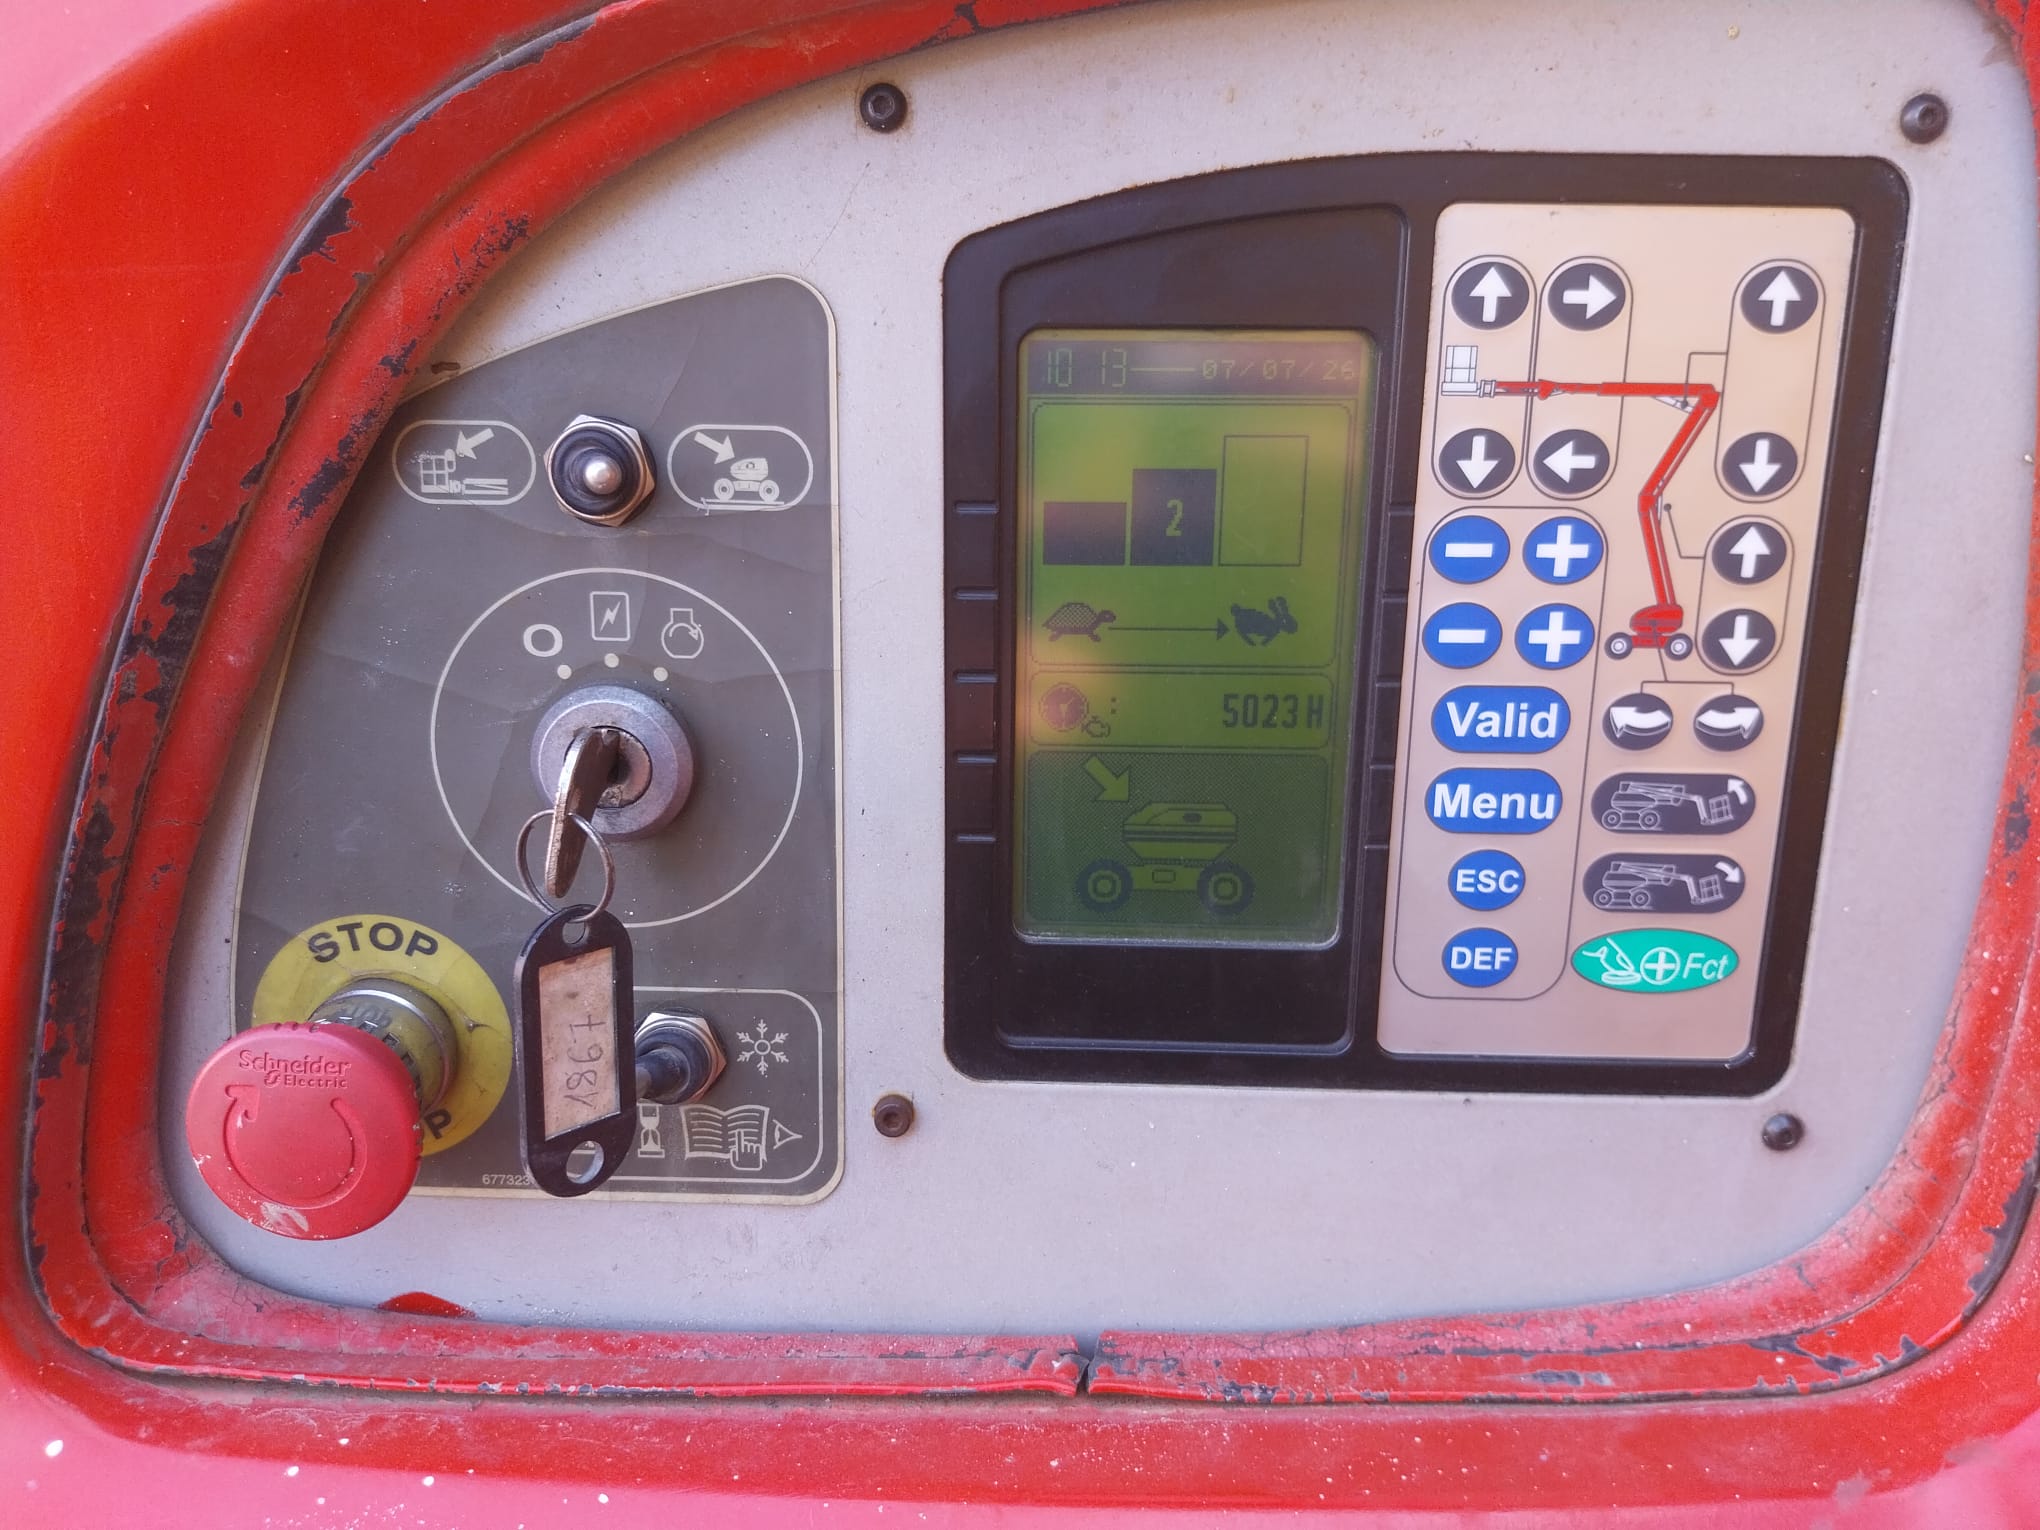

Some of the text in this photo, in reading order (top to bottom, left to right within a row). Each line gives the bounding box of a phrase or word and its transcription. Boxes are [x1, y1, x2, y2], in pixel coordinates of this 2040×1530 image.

[1202, 359, 1356, 382] 07/07/26
[1165, 499, 1184, 537] 2
[1222, 693, 1325, 730] 5023 H
[1446, 702, 1559, 738] Valid
[1432, 783, 1557, 819] Menu
[1455, 869, 1520, 894] ESC
[307, 921, 439, 964] STOP
[1450, 946, 1513, 970] DEF
[1682, 953, 1729, 979] Fct
[239, 1049, 352, 1077] Schneider
[284, 1074, 349, 1089] Electric
